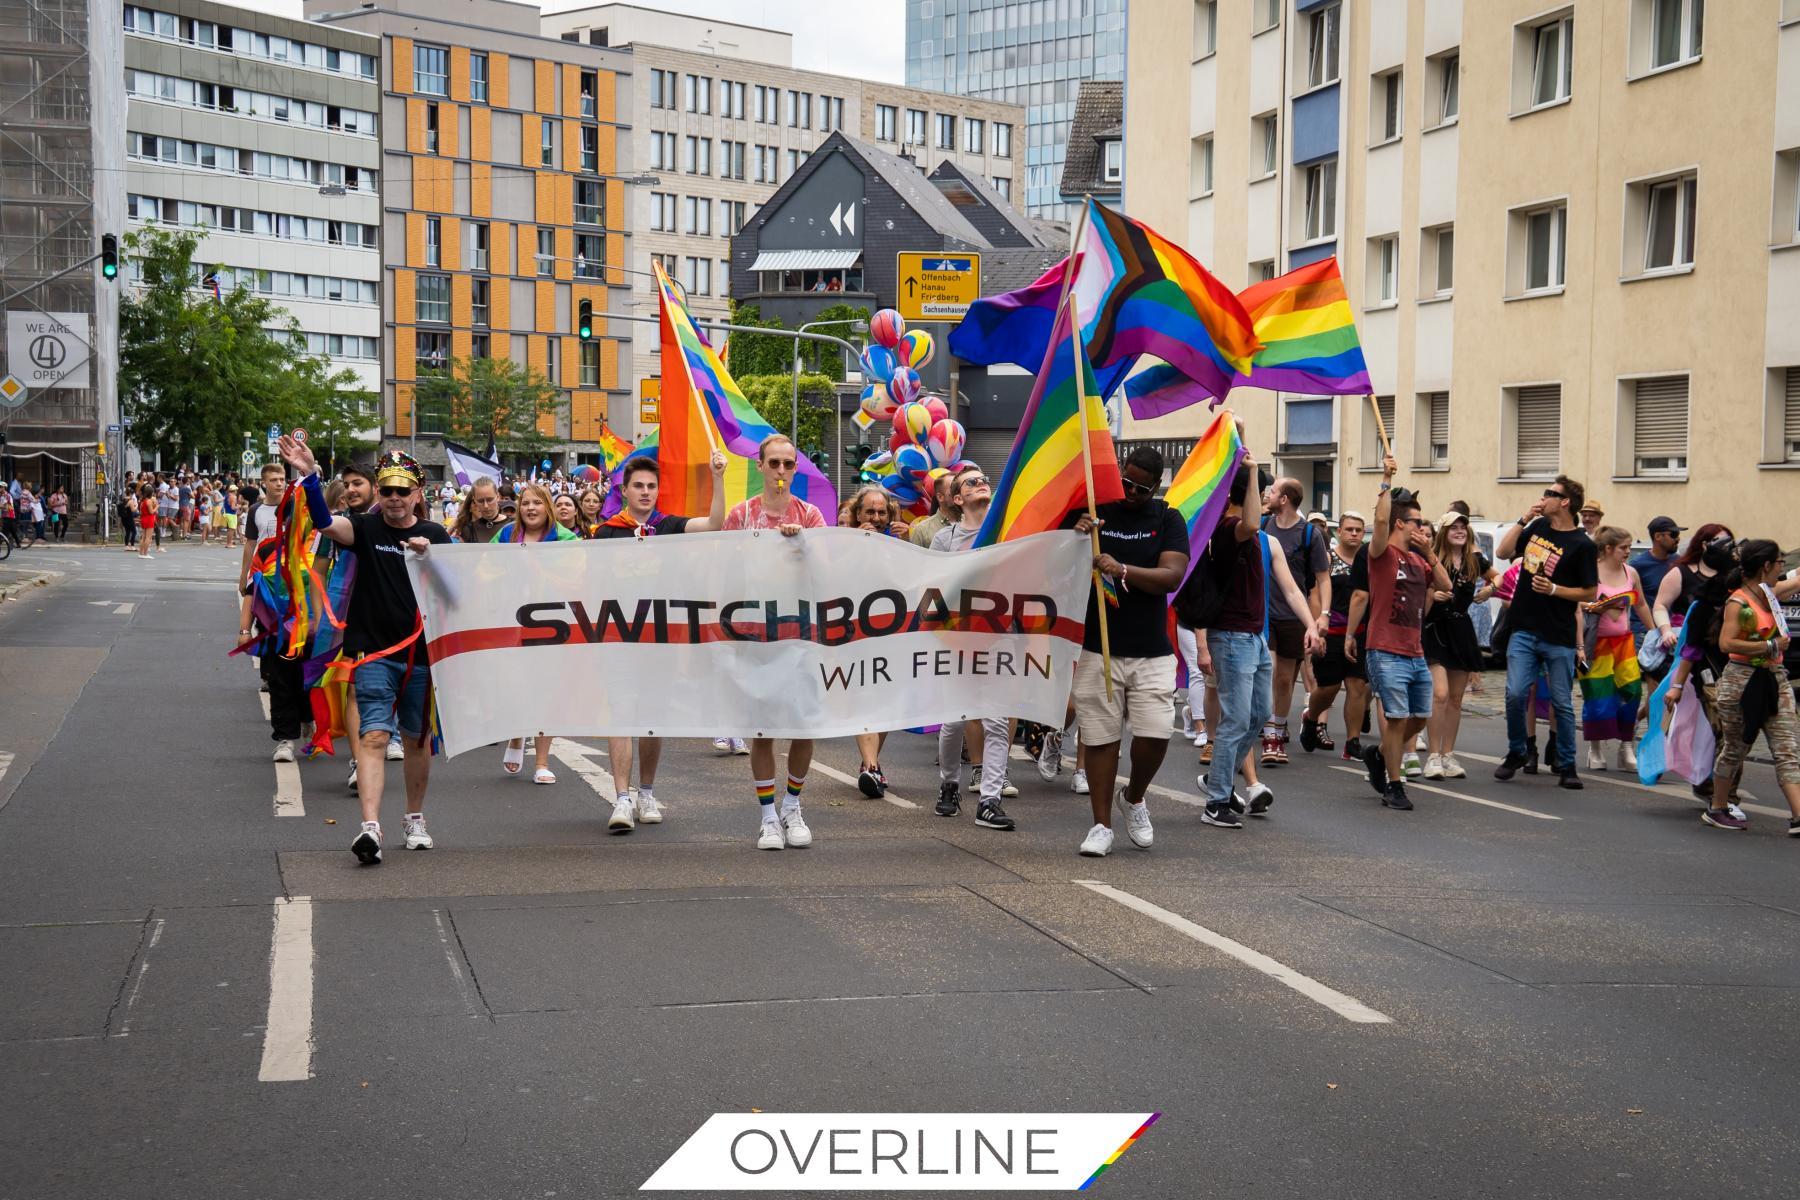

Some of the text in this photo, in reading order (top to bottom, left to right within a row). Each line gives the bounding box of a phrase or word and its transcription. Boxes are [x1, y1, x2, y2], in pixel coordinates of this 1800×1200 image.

[921, 273, 961, 282] Offenbach
[921, 283, 946, 291] Hanau
[921, 293, 960, 303] Friedberg
[25, 323, 71, 334] WE ARE
[33, 370, 65, 380] OPEN
[295, 432, 304, 440] 40
[1101, 530, 1139, 540] switchboard
[515, 587, 1058, 647] SWITCHBOARD
[819, 650, 1051, 692] WIR FEIERN
